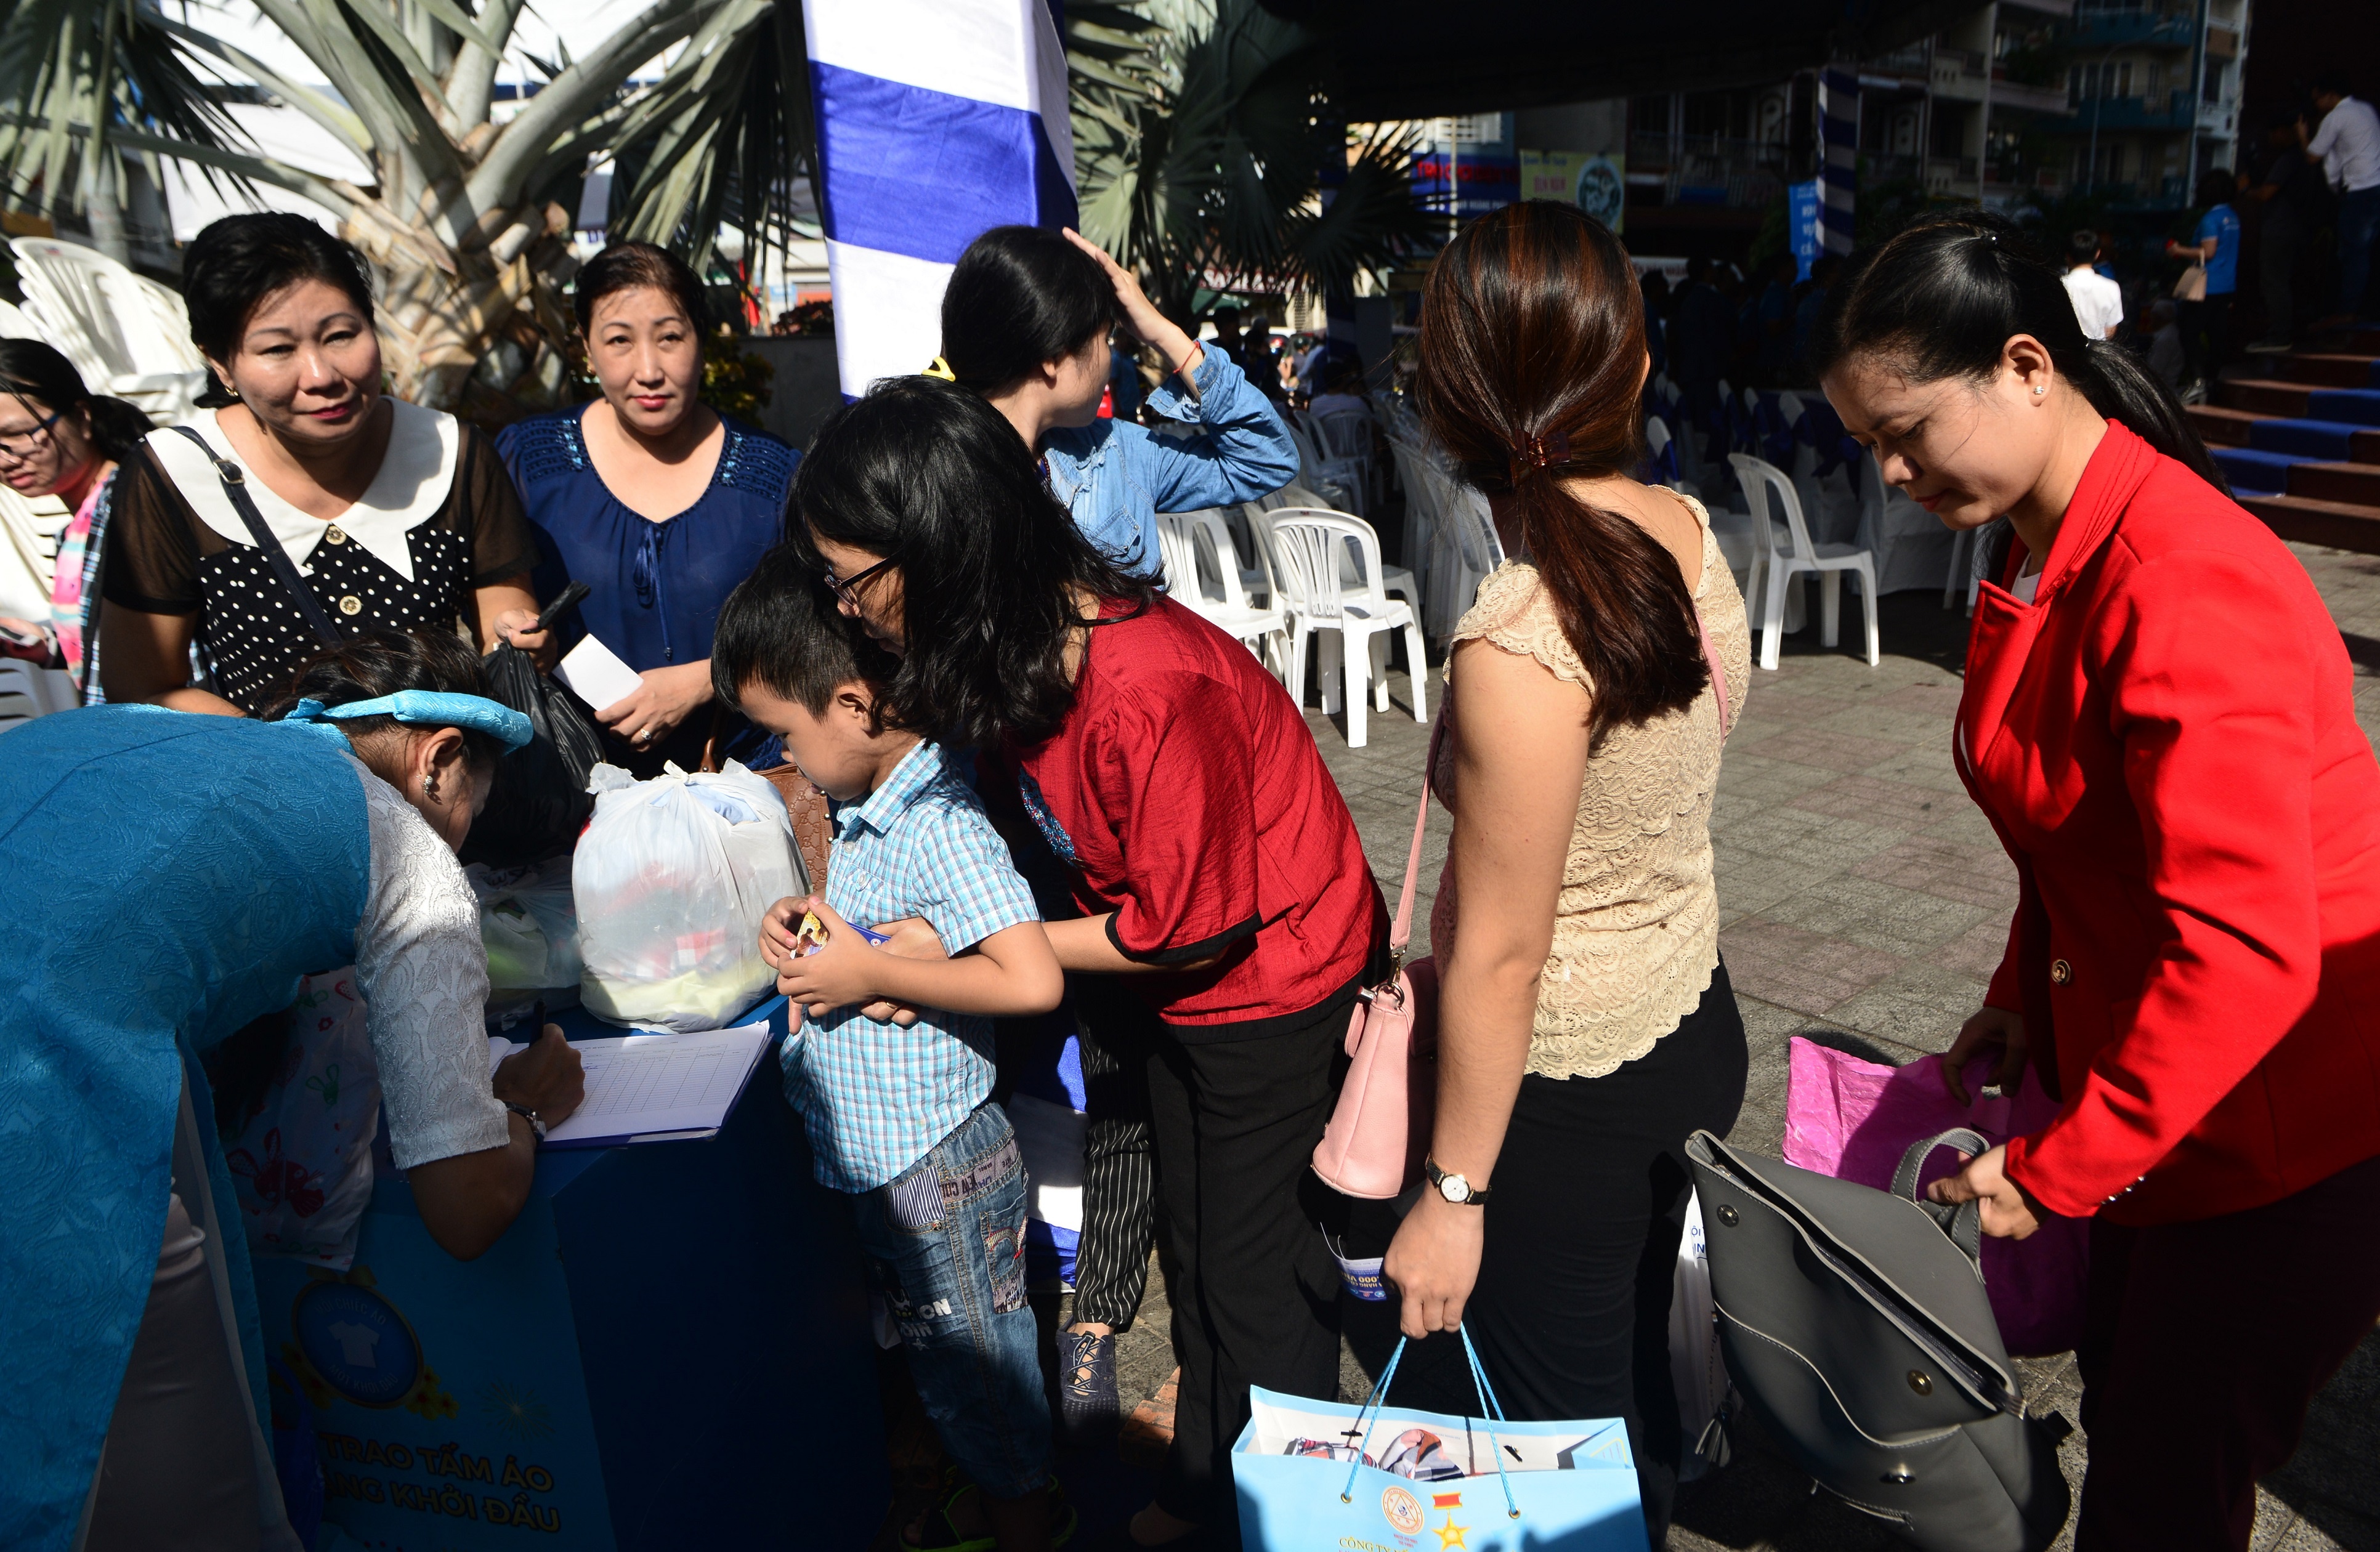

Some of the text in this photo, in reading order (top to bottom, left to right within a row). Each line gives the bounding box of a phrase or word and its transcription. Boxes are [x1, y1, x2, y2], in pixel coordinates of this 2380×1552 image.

[318, 1431, 554, 1493] TRAO TẤM ÁO
[389, 1482, 478, 1521] KHỞI
[483, 1493, 561, 1533] ĐẦU
[1338, 1536, 1374, 1552] CÔNG
